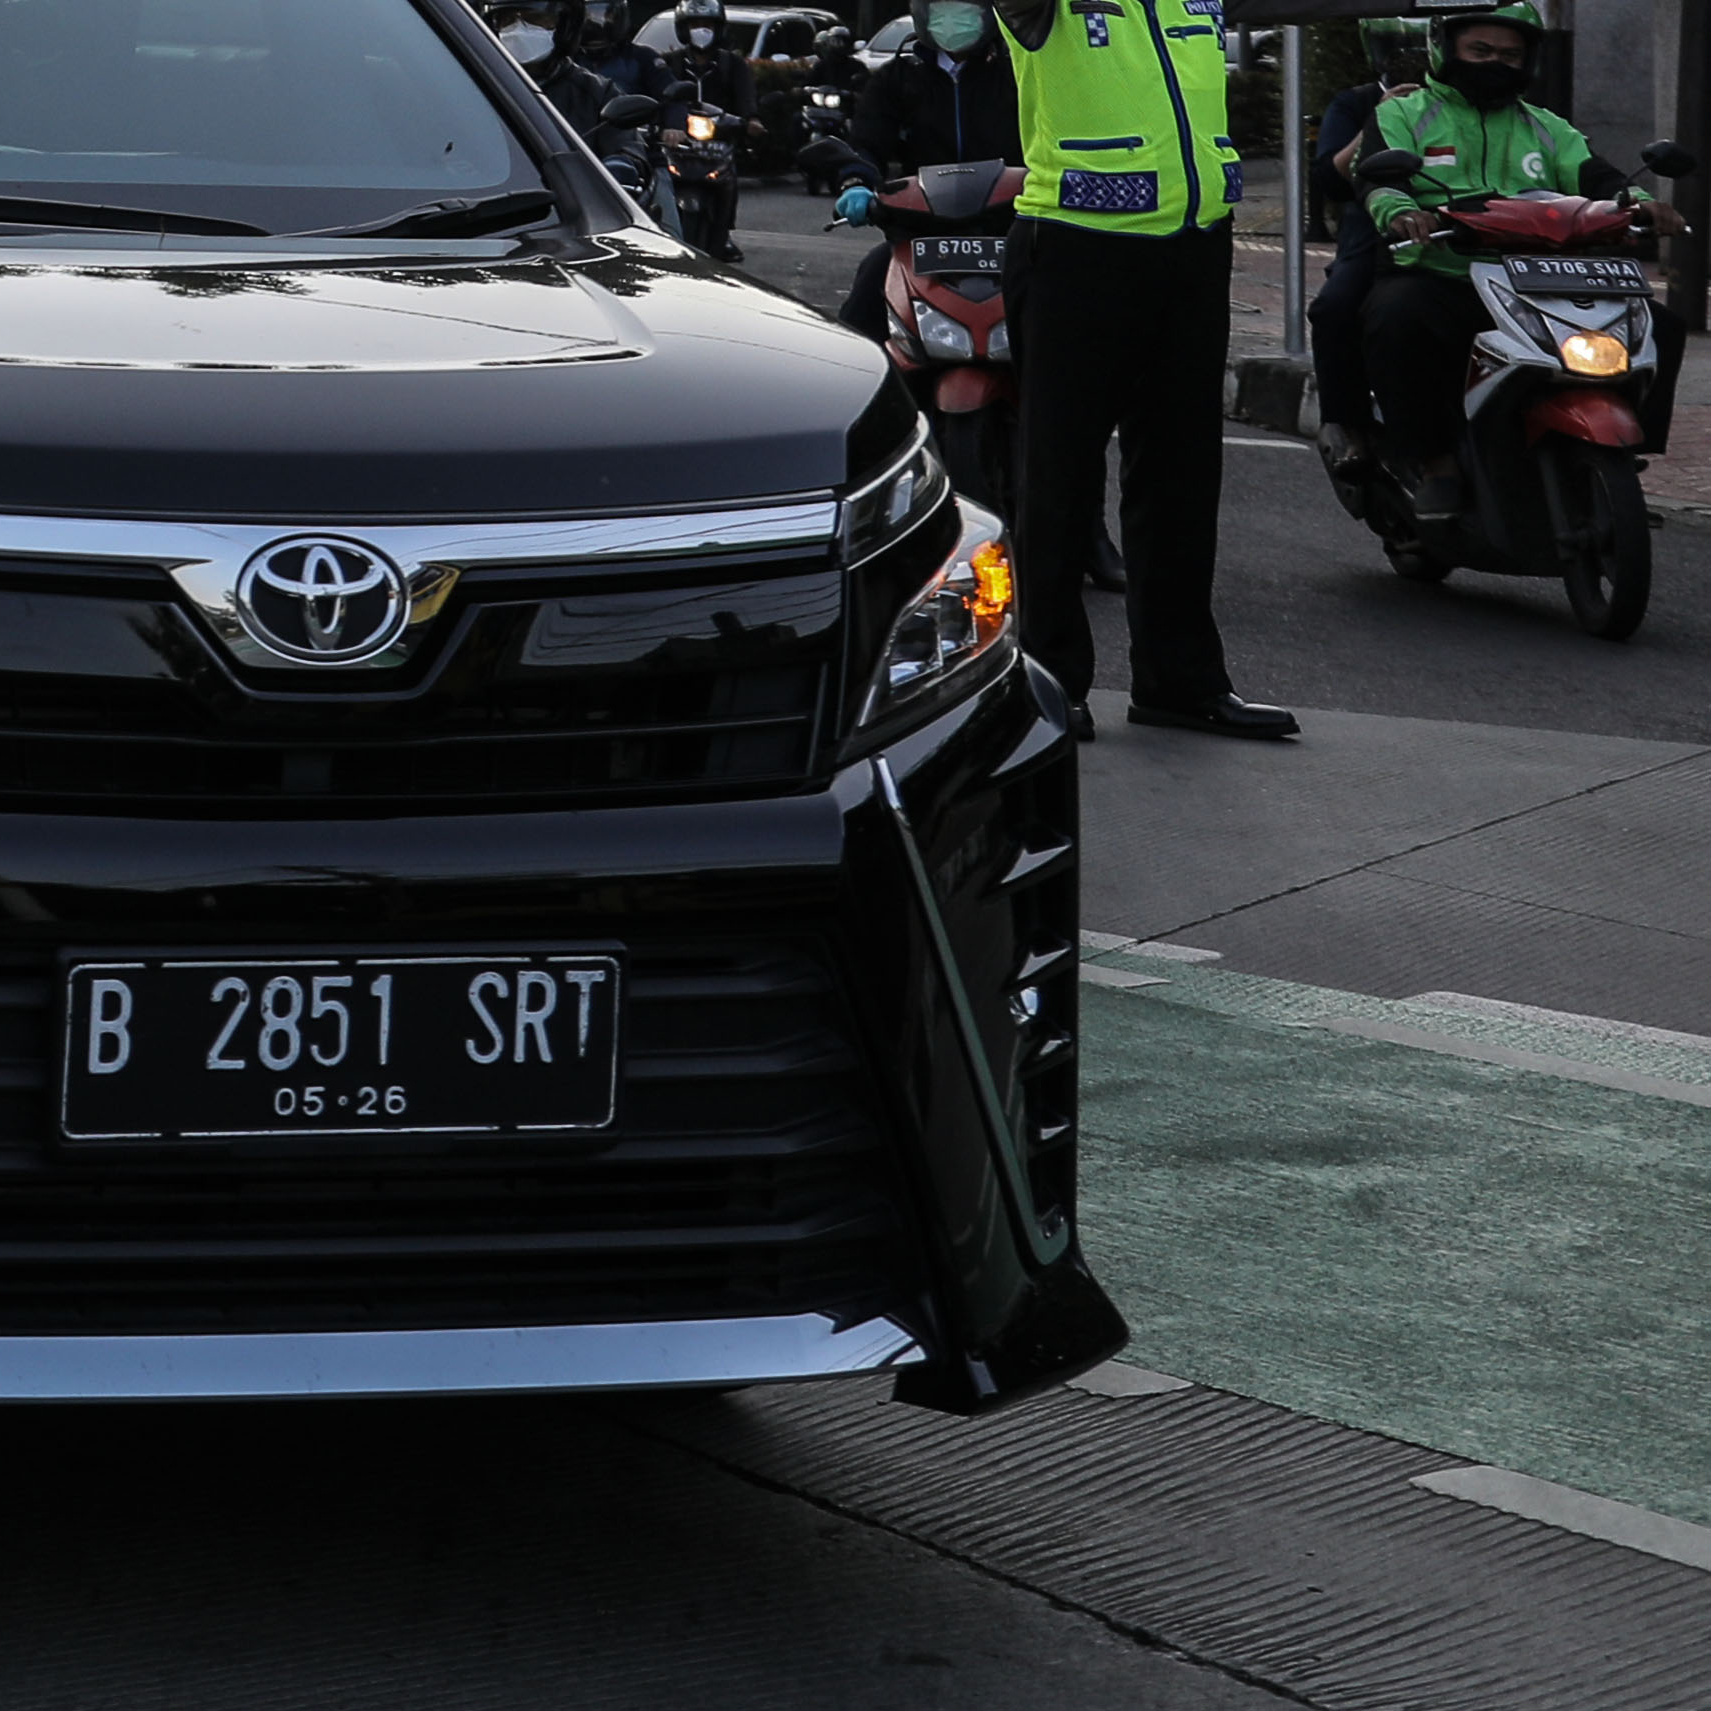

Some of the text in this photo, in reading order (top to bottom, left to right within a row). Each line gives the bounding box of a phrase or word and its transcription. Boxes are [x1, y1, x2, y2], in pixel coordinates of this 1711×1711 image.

[916, 241, 926, 256] B
[938, 240, 983, 254] 6705
[978, 259, 998, 268] 06
[1513, 260, 1635, 276] B 3706 SWA
[87, 970, 606, 1074] B 2851 SRT
